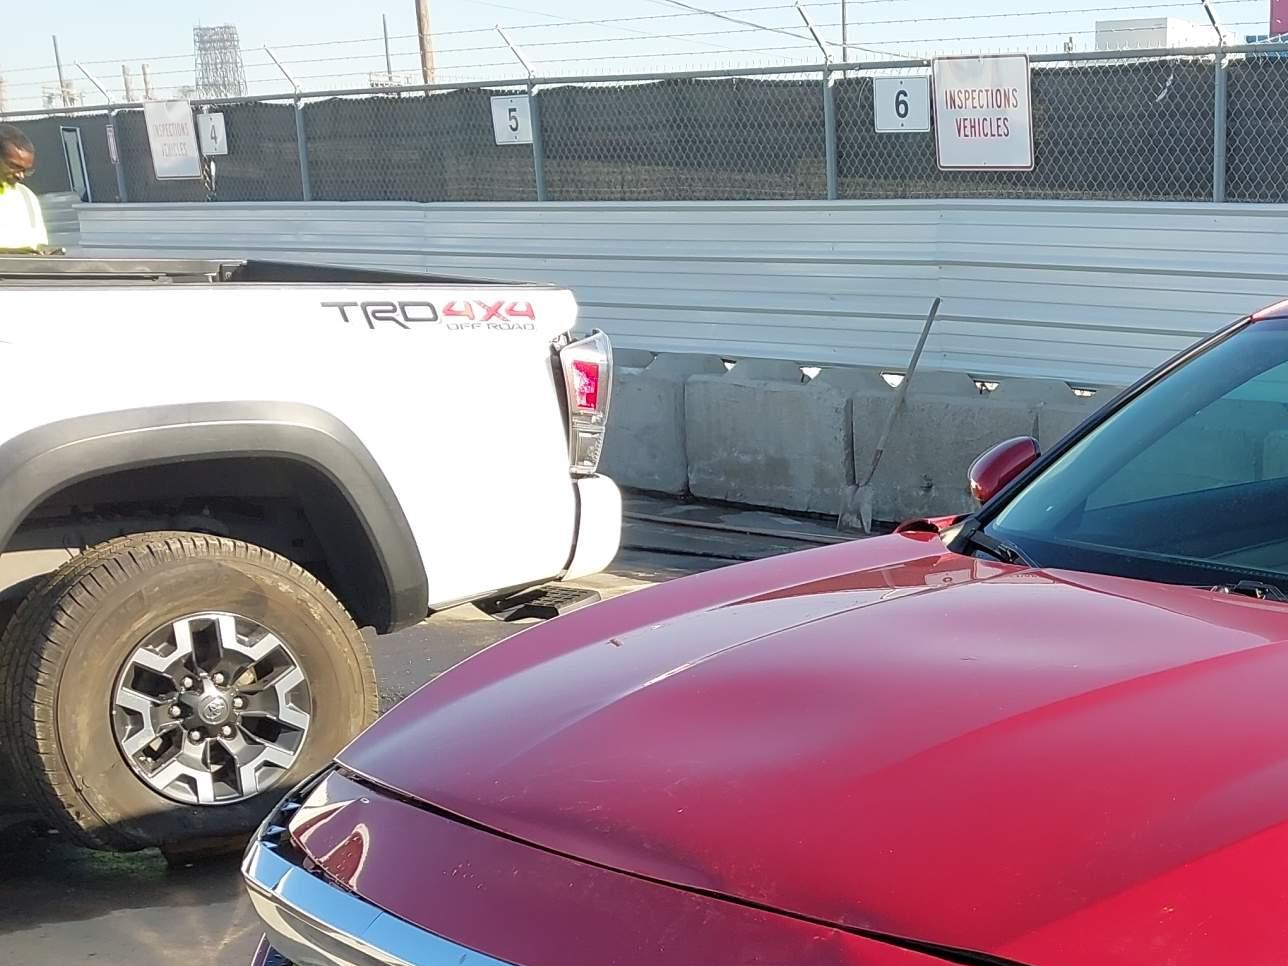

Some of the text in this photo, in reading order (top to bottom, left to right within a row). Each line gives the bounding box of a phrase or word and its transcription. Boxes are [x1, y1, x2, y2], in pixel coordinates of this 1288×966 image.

[894, 89, 909, 119] 6
[944, 88, 1018, 110] INSPECTIONS
[508, 107, 519, 132] 5
[955, 117, 1010, 138] VEHICLES
[210, 124, 218, 145] 4
[320, 301, 536, 330] TRD 4X4
[446, 322, 536, 331] OFF ROAD
